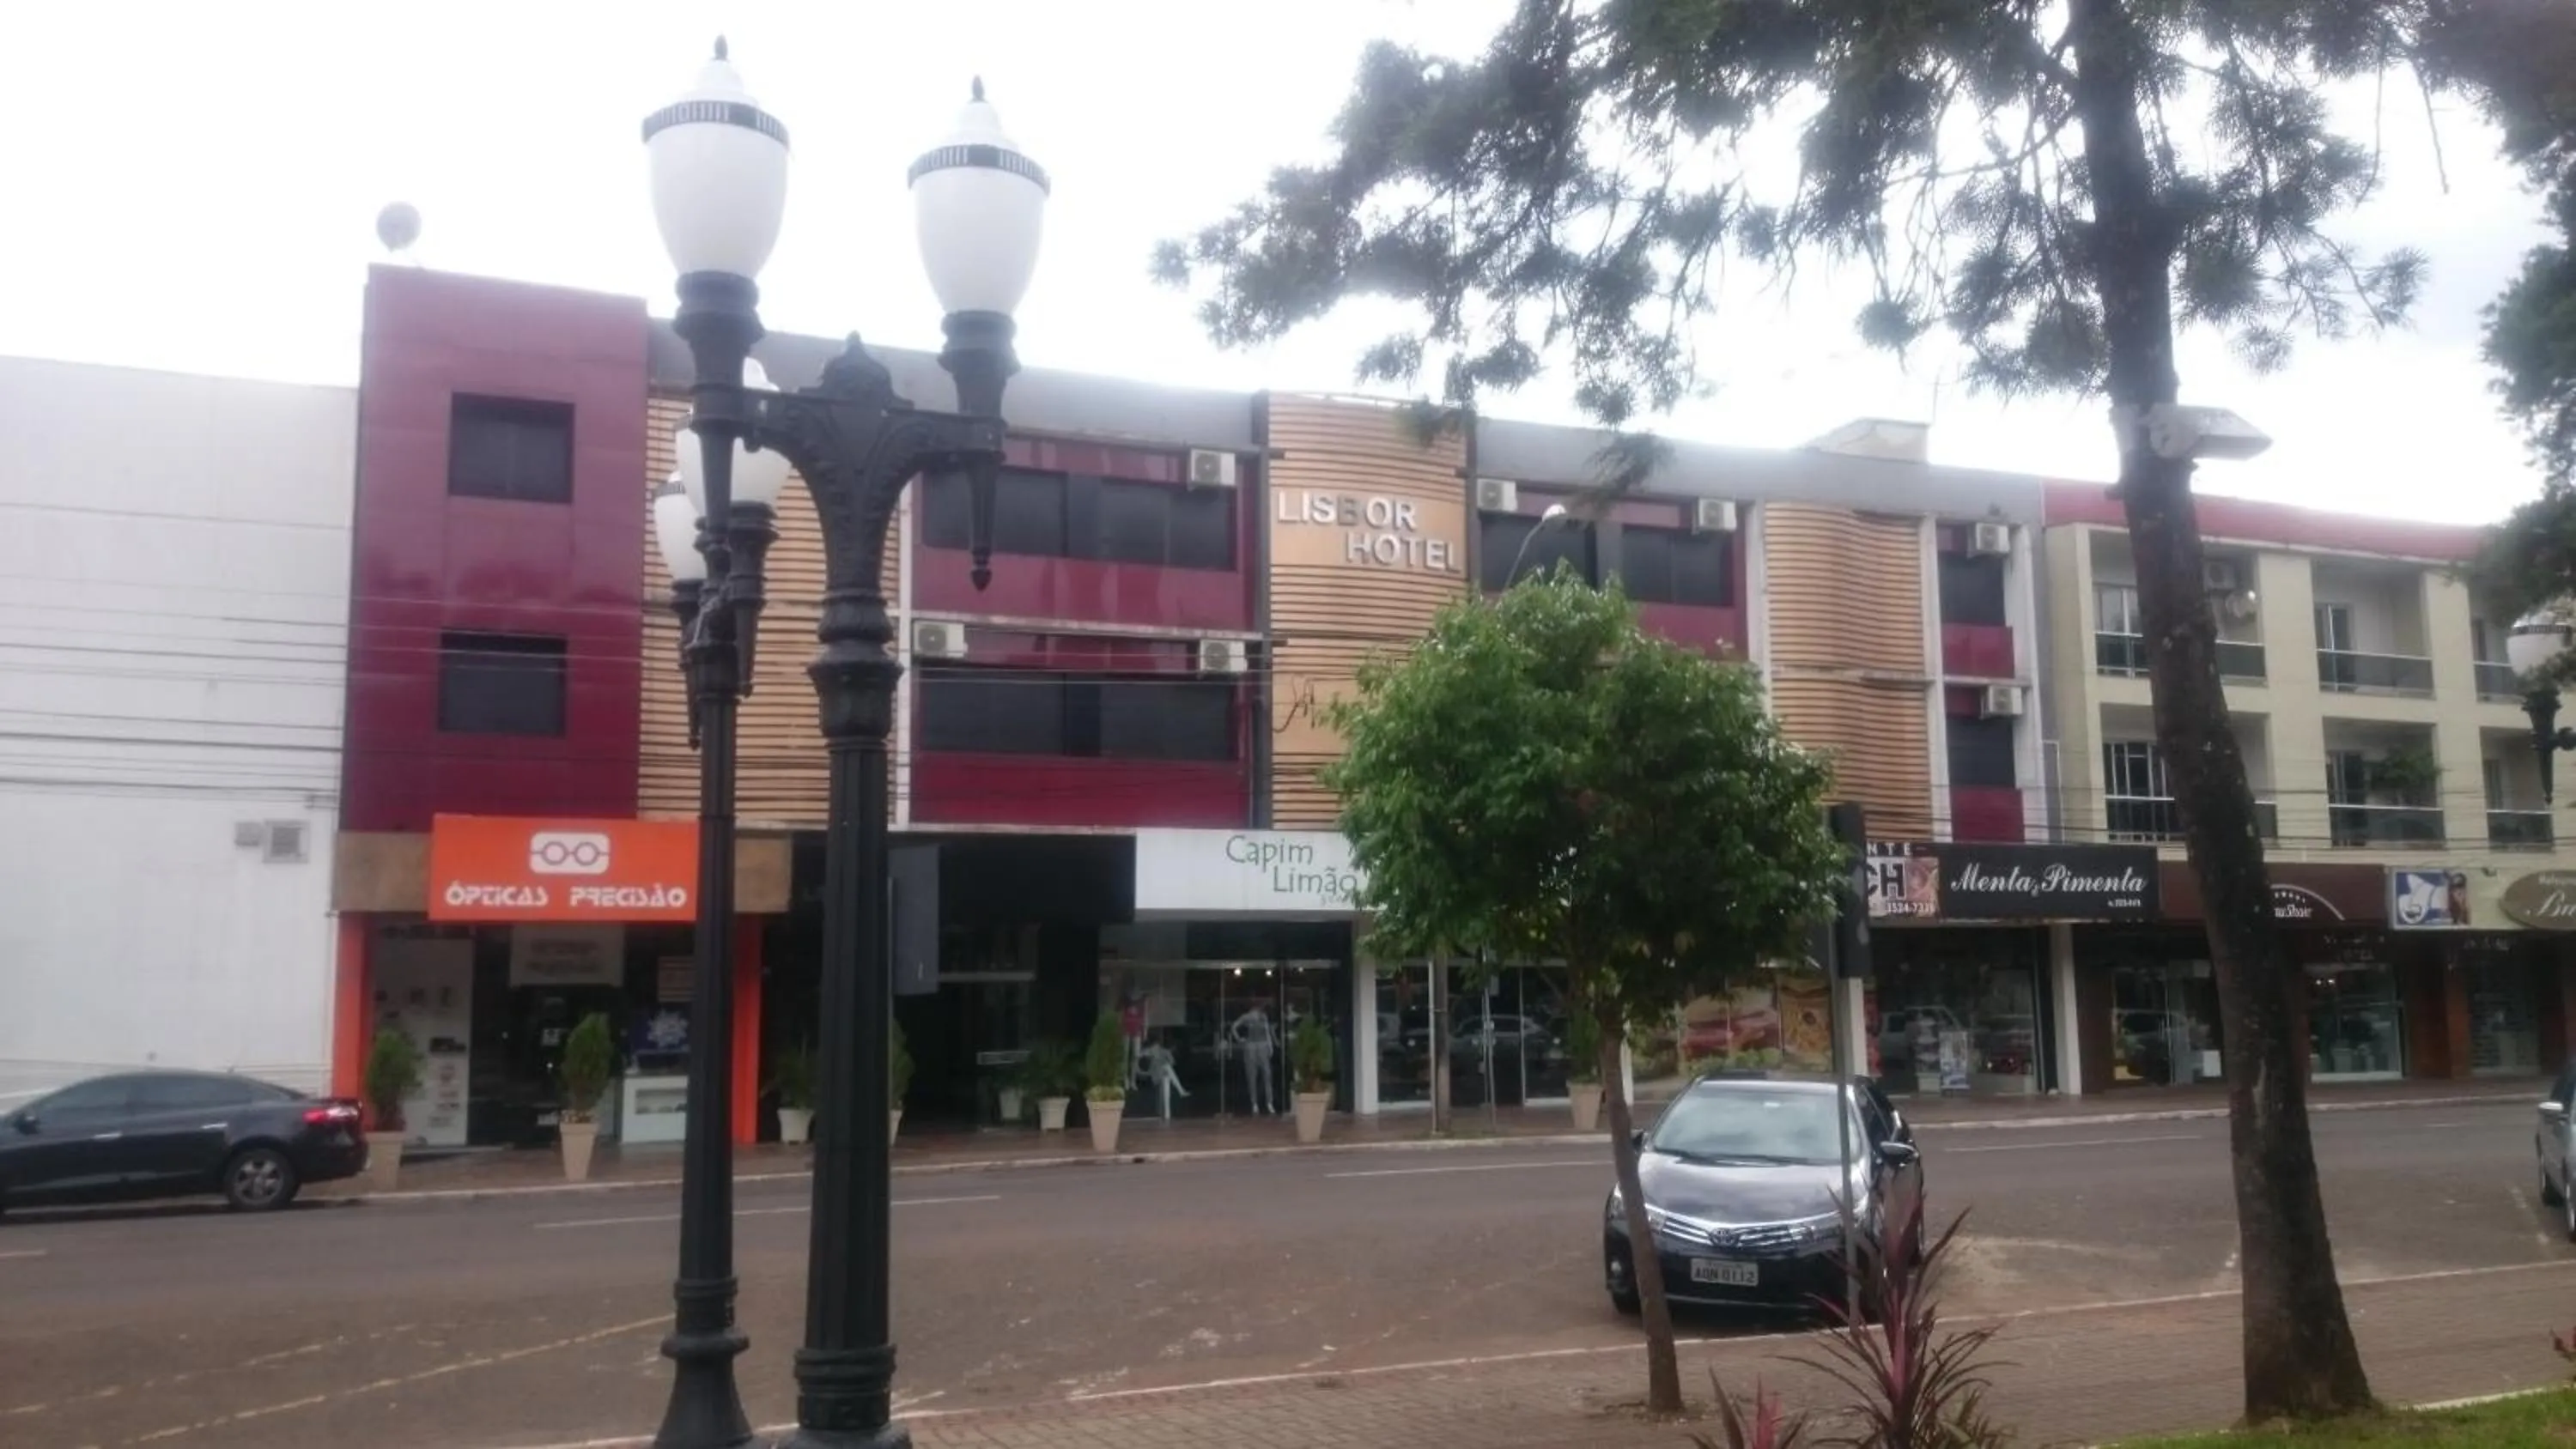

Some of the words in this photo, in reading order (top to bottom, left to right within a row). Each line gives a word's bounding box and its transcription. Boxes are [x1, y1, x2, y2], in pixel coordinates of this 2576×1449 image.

[1346, 531, 1461, 573] HOTEL
[1226, 834, 1314, 873] Capim
[1273, 865, 1358, 895] Limão
[1951, 862, 2032, 892] Menta
[2041, 863, 2146, 893] Pimenta
[444, 880, 549, 906] ÓPTICAS
[569, 882, 686, 907] PRECISÃO
